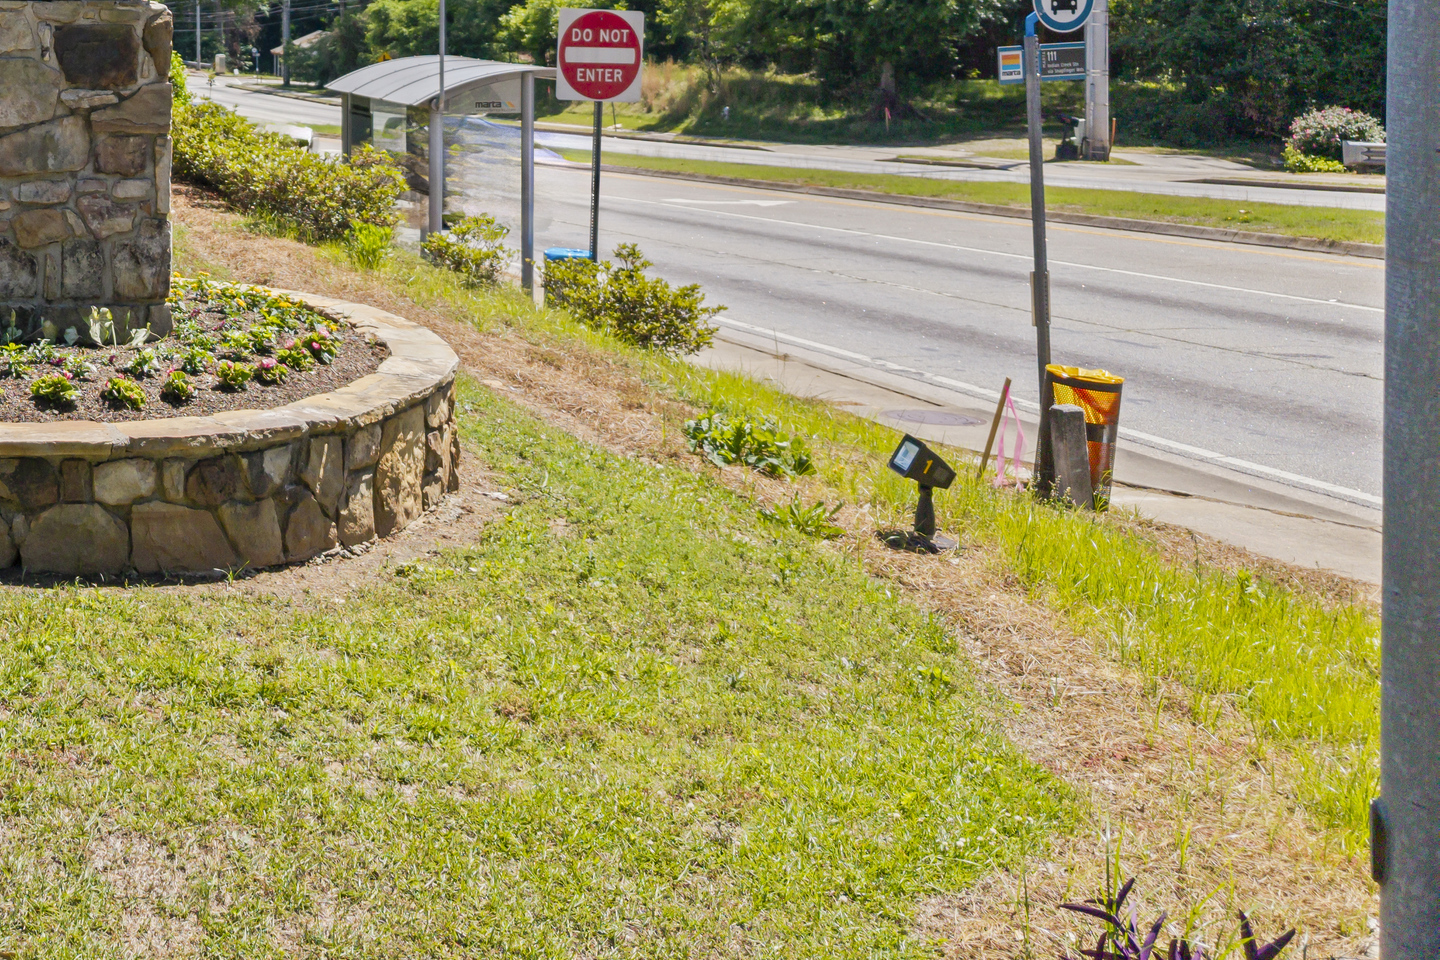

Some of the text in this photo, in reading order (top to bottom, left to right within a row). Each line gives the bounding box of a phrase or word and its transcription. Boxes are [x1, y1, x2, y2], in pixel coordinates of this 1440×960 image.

[571, 28, 629, 43] DO NOT
[1047, 51, 1057, 61] 111
[576, 68, 623, 82] ENTER
[923, 460, 933, 474] 1
